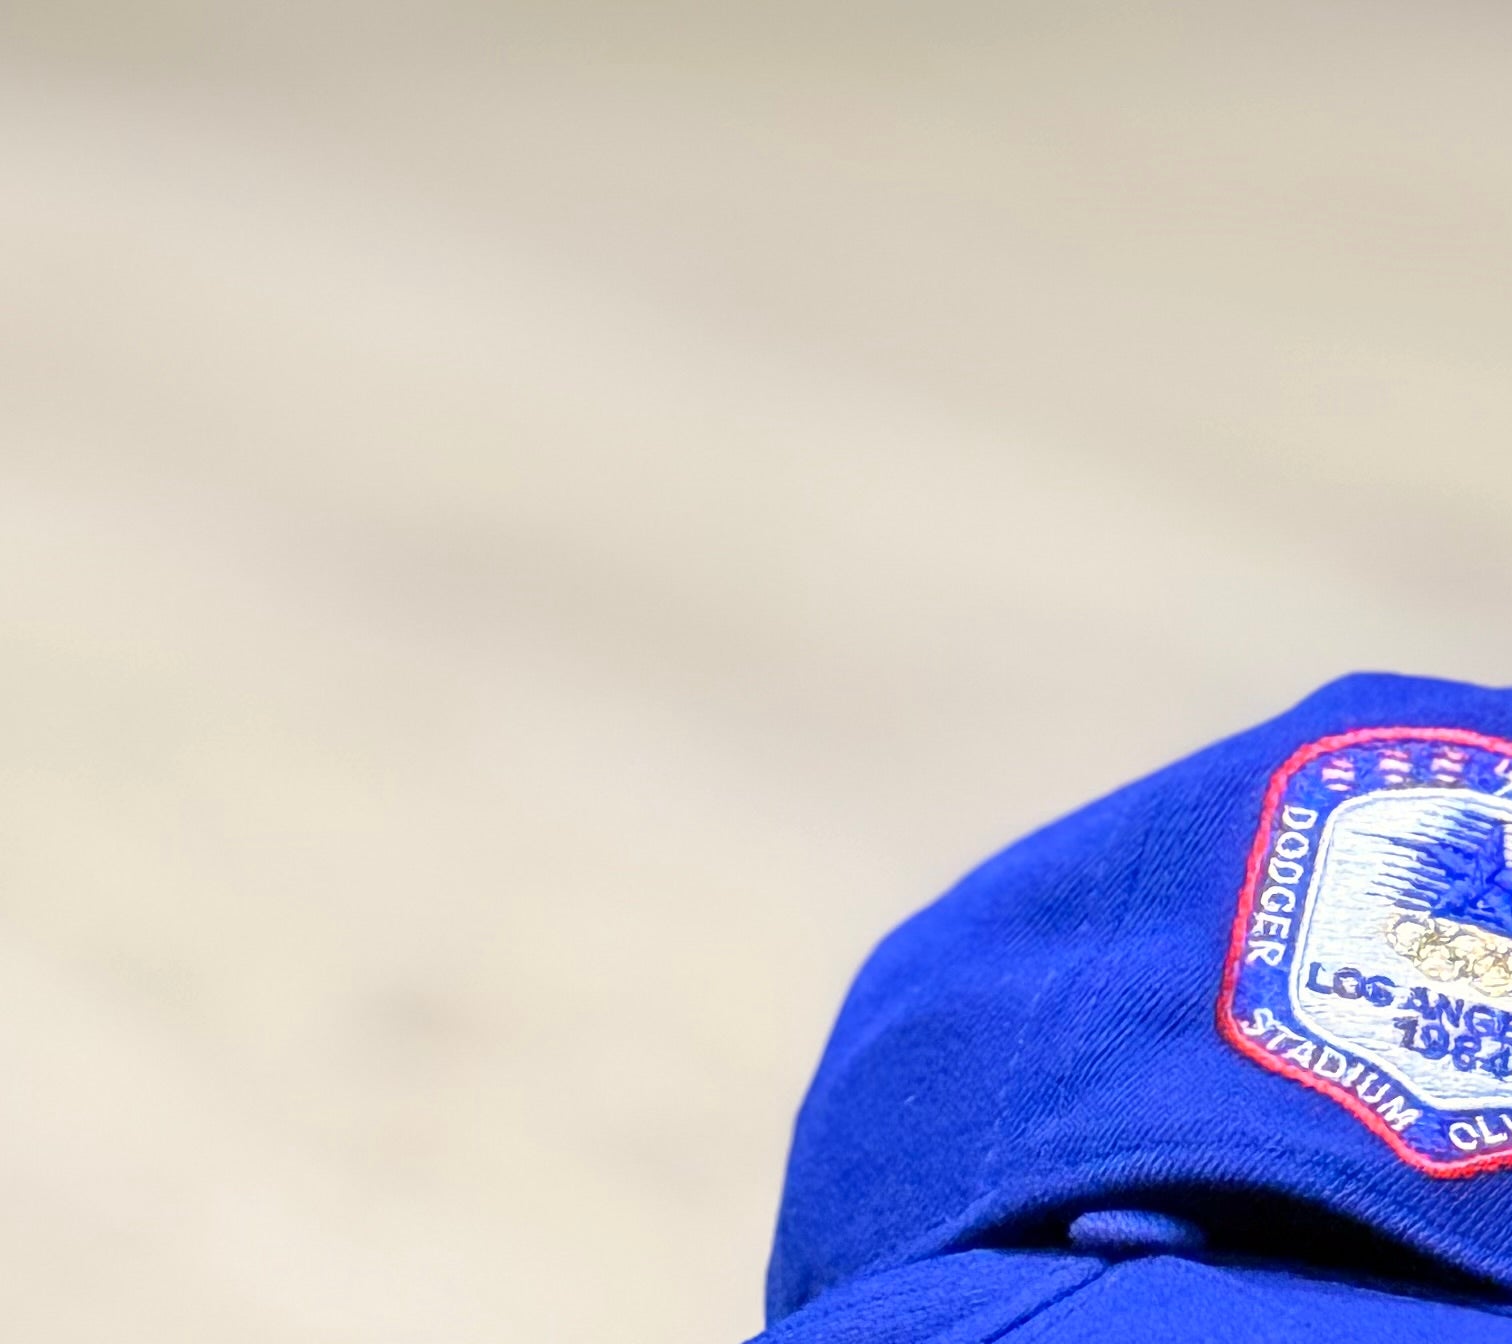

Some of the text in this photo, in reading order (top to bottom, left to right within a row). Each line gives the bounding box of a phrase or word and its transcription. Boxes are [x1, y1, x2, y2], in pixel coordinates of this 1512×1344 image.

[1244, 804, 1318, 967] DODGER
[1306, 962, 1395, 1007] LOS
[1241, 1007, 1422, 1132] STADIUM
[1393, 1015, 1512, 1080] 1984
